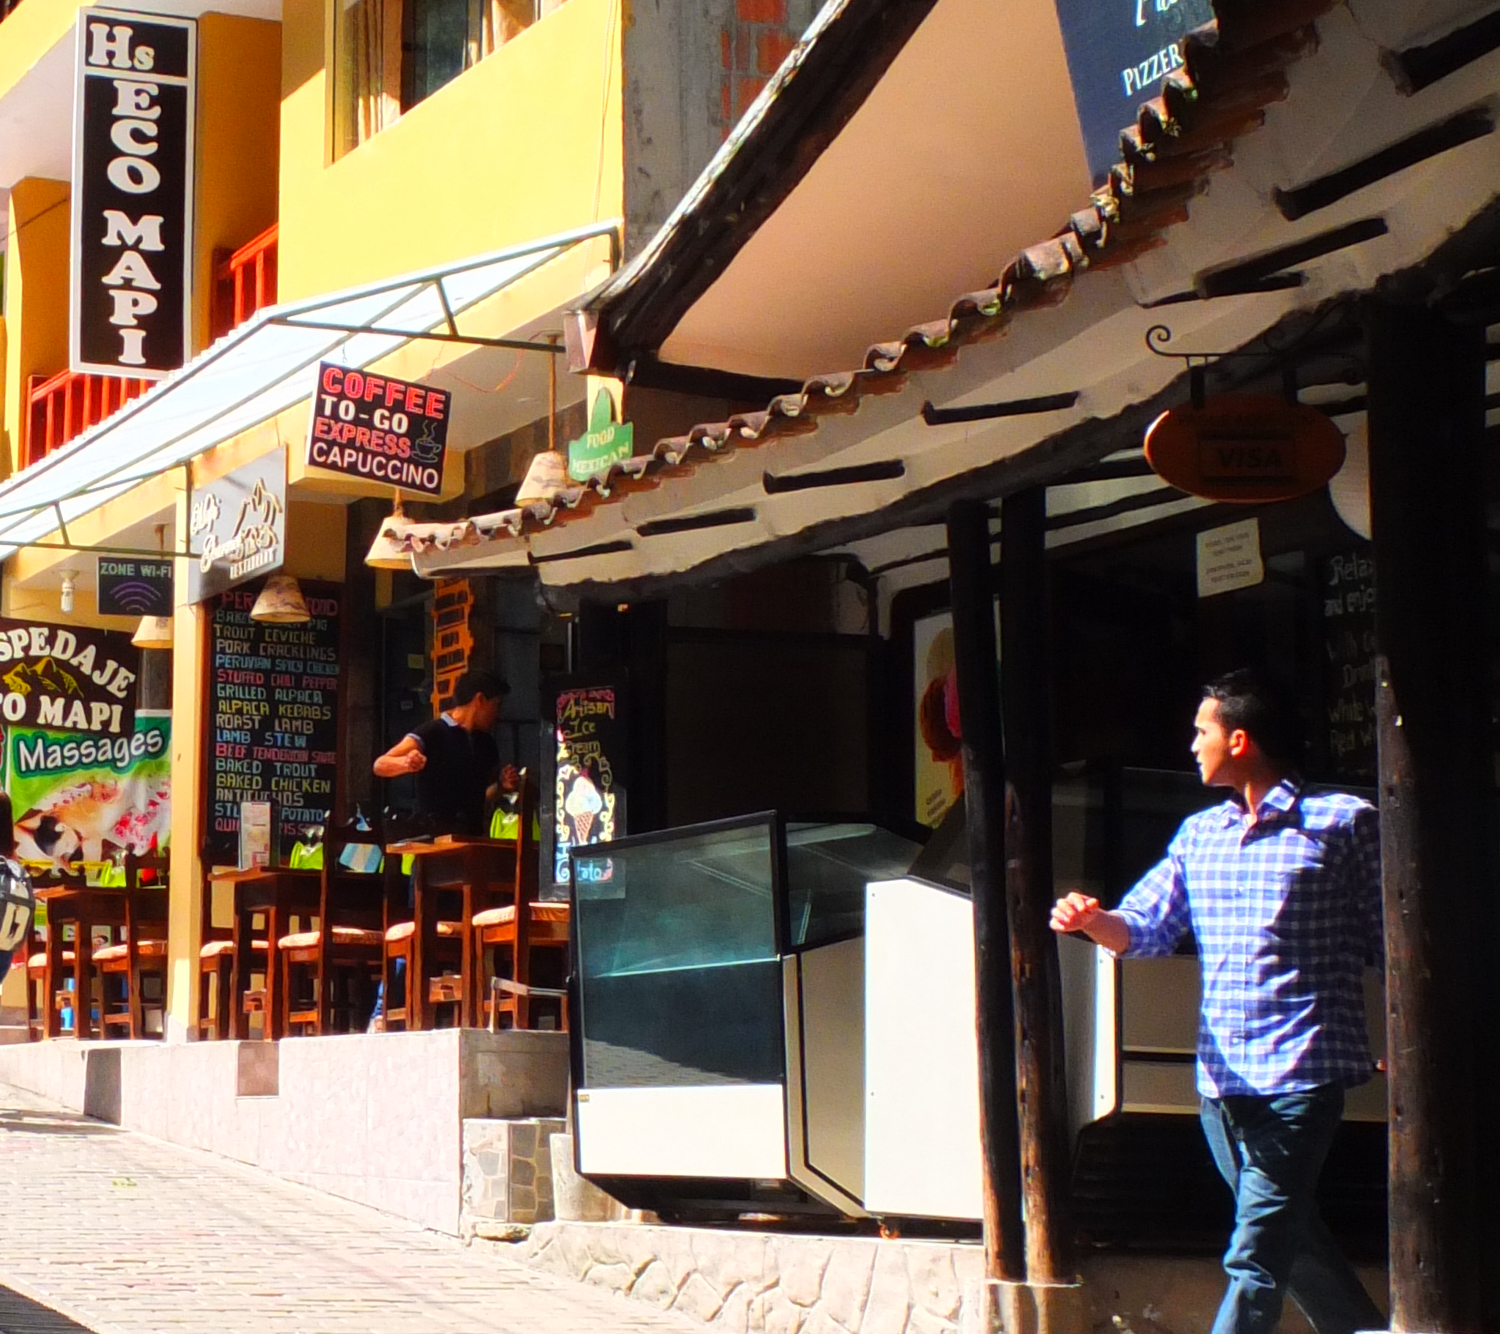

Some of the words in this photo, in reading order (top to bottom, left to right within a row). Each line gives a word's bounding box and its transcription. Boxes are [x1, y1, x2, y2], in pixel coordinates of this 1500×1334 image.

[1121, 43, 1184, 97] PIZZER
[107, 80, 162, 194] ECO
[101, 209, 165, 364] MAPI
[322, 367, 446, 419] COFFEE
[315, 417, 411, 458] EXPRESS
[313, 442, 438, 488] CAPUCCINO
[1218, 447, 1282, 468] VISA
[100, 562, 135, 576] ZONE
[140, 564, 172, 578] WI-FI
[213, 624, 256, 638] TROUT
[264, 629, 316, 645] CEVICHE
[216, 639, 251, 654] PORK
[259, 643, 336, 661] CRACKLINGS
[215, 654, 271, 670] PERUVIAN
[275, 658, 304, 673] SPICY
[217, 670, 264, 685] STUFFED
[217, 684, 266, 699] GRILLED
[275, 688, 323, 704] ALPACA
[37, 695, 123, 733] MAPI
[218, 700, 270, 716] ALPACA
[279, 704, 331, 720] KEBABS
[216, 713, 261, 729] ROAST
[274, 718, 314, 734] LAMB
[216, 730, 251, 743] LAMB
[264, 732, 307, 748] STEW
[18, 728, 163, 772] Massages
[215, 743, 247, 759] BEEF
[215, 758, 262, 774] BAKED
[274, 762, 317, 778] TROUT
[216, 773, 262, 789] BAKED
[271, 777, 331, 793] CHICKEN
[281, 807, 324, 821] POTATO
